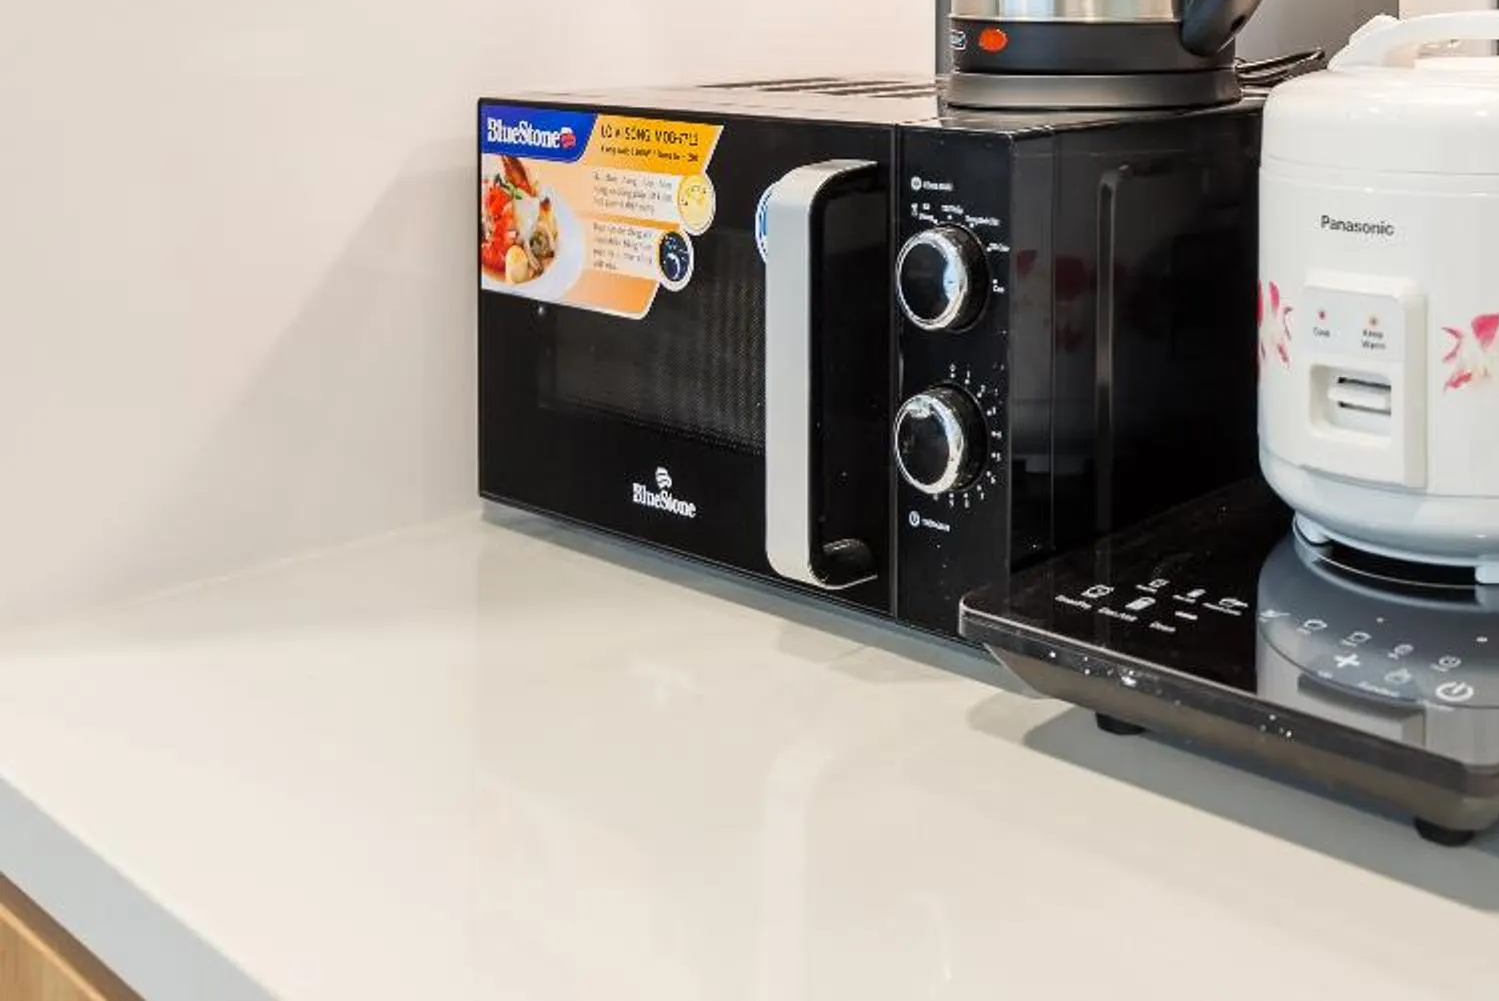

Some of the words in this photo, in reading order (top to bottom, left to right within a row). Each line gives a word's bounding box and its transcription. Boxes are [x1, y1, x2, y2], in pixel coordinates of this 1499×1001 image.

[487, 117, 561, 149] BlueStone
[1320, 214, 1395, 236] Panasonic
[632, 482, 697, 518] BlueStone
